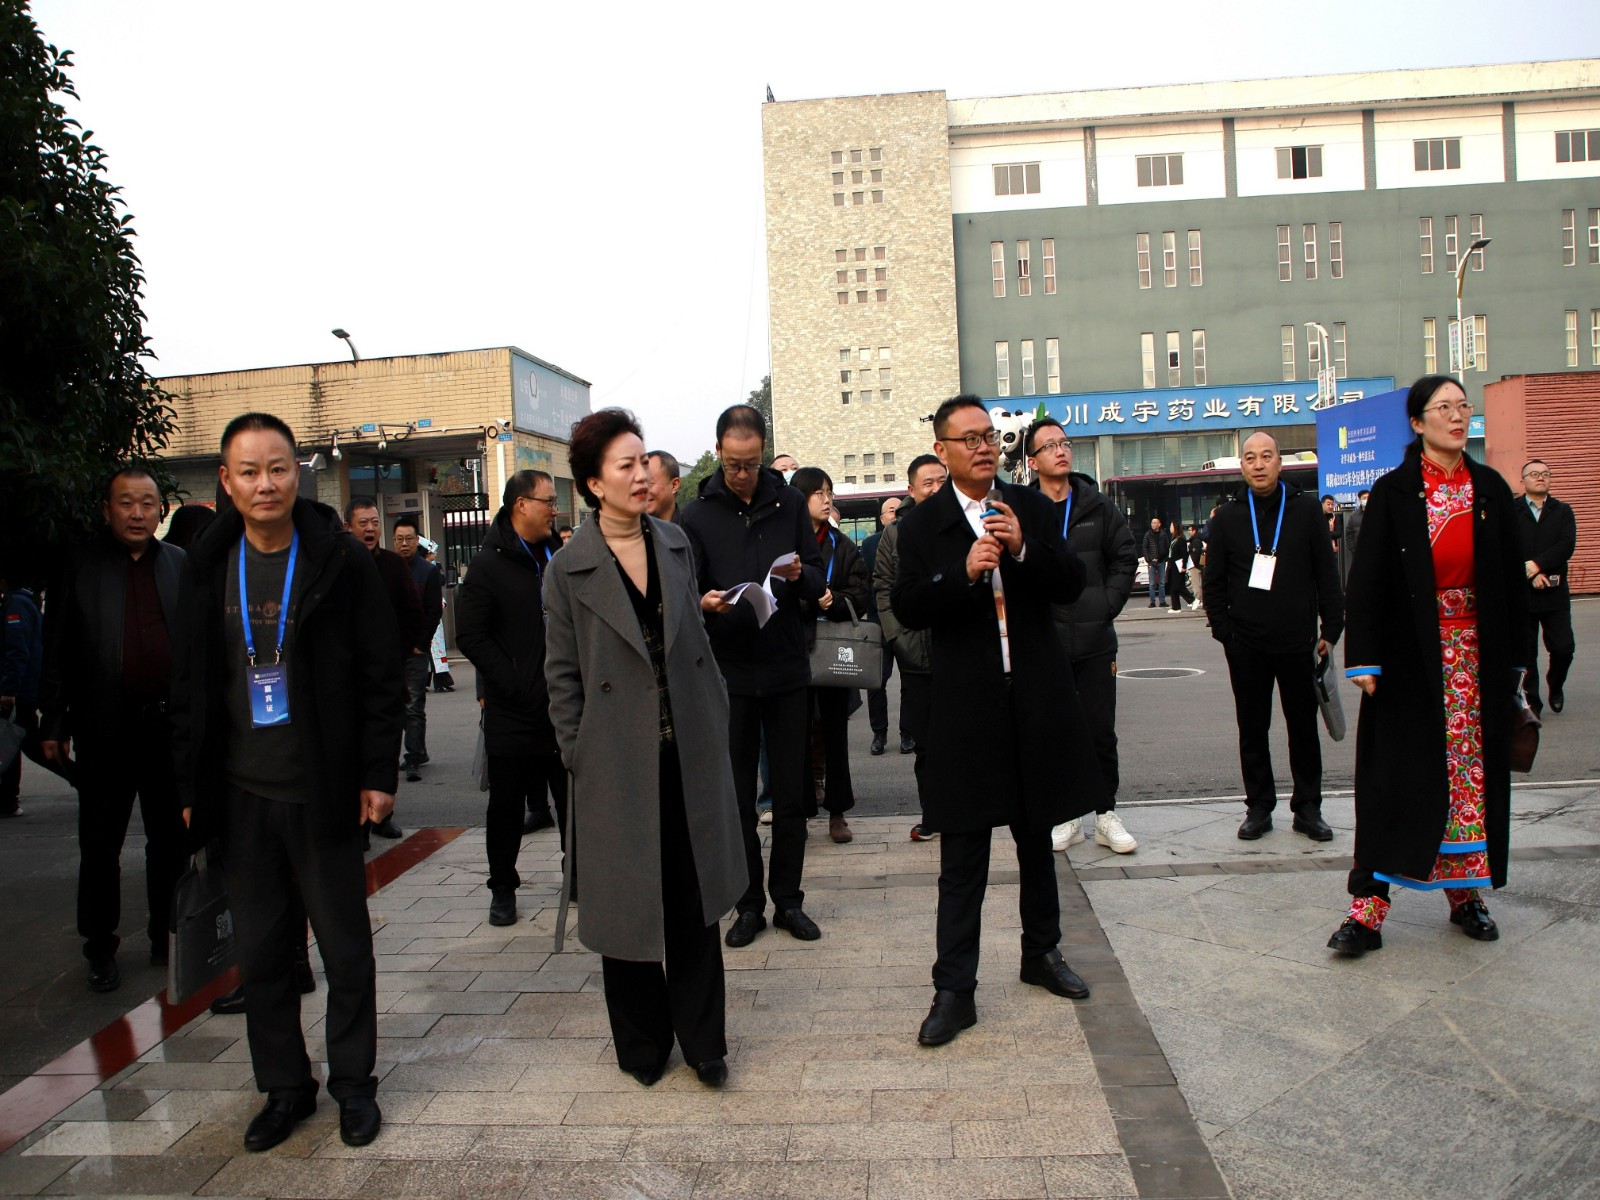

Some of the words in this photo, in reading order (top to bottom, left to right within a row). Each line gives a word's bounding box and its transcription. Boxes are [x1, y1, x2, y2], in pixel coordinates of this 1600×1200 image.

[1033, 391, 1364, 426] 川成宇药业有限公司
